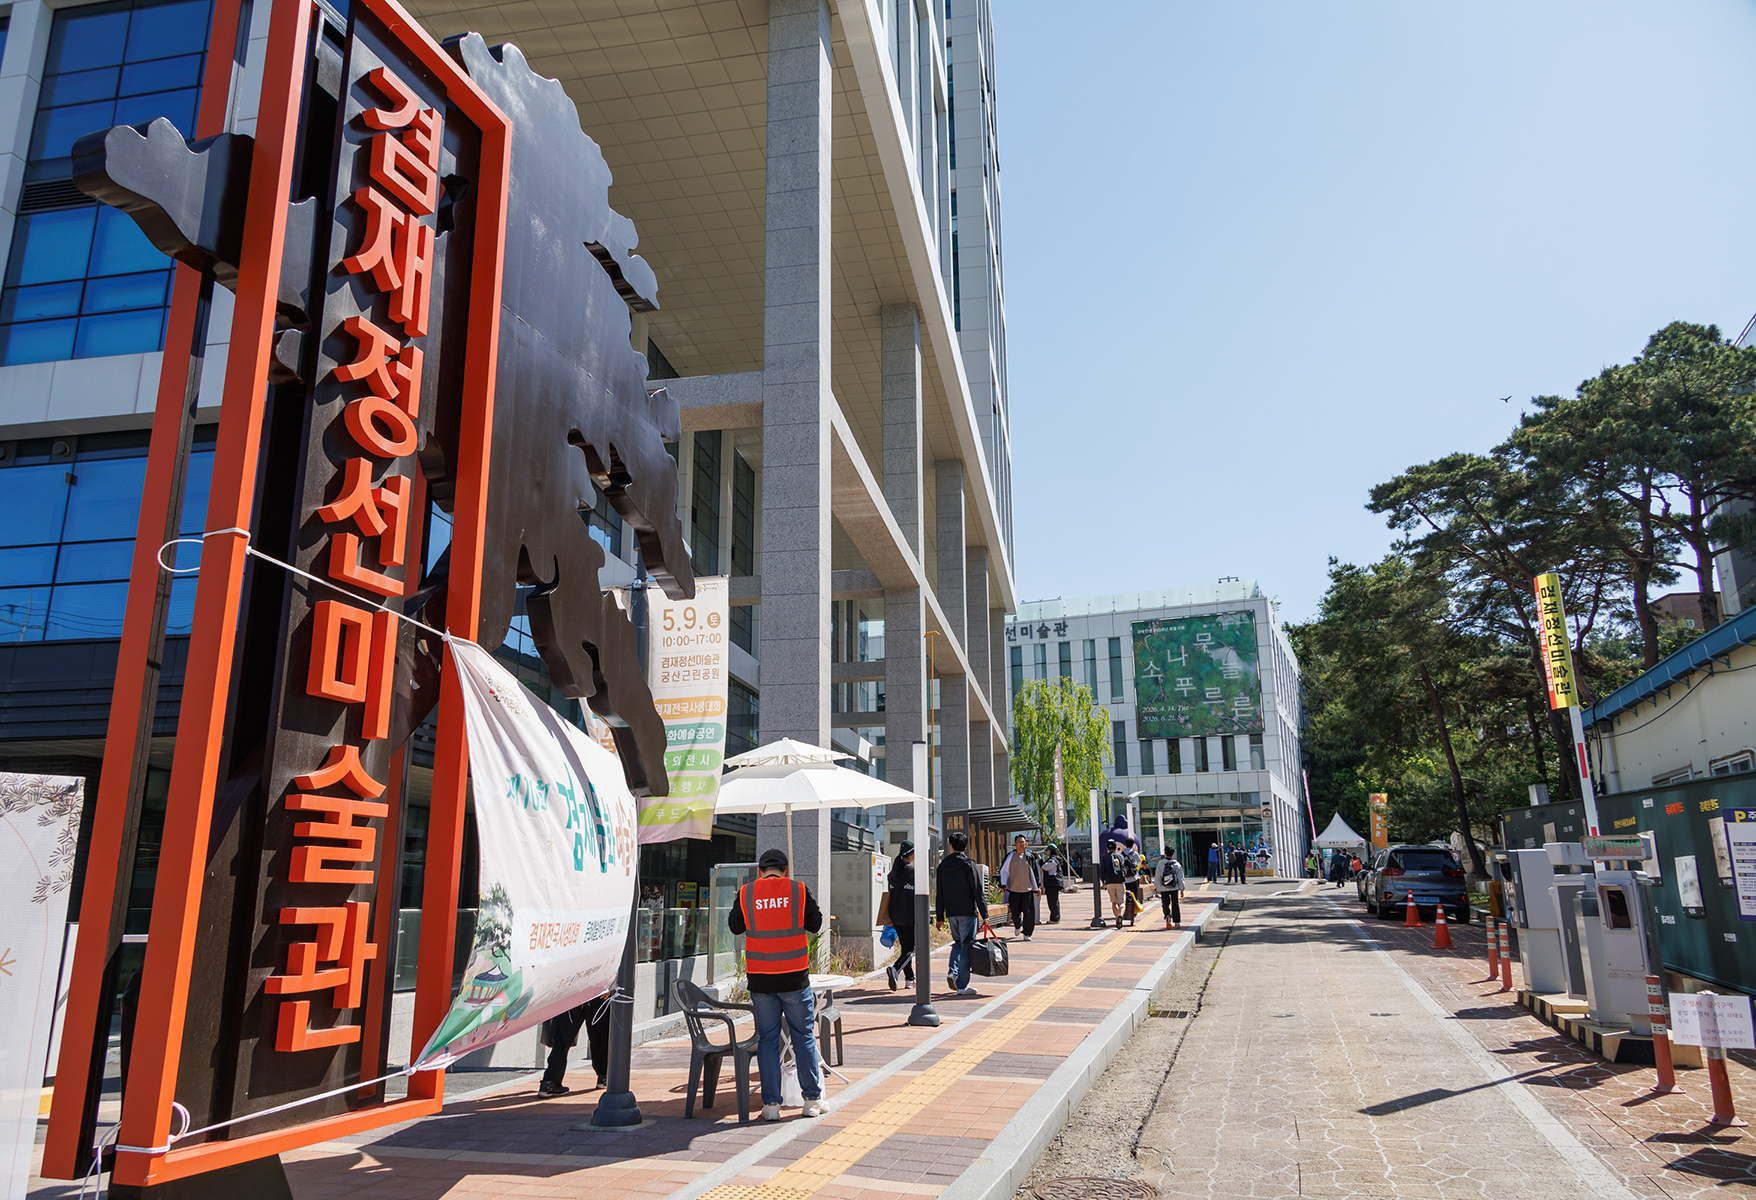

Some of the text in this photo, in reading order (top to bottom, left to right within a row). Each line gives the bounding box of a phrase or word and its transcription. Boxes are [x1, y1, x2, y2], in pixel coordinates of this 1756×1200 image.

[264, 66, 443, 1052] 겸재정선미술관
[662, 606, 720, 632] 5.9. 토
[662, 633, 722, 647] 10:00-17:00
[1005, 621, 1068, 642] 선미술관
[1541, 585, 1571, 695] 겸재정선미술관
[662, 654, 720, 668] 겸재정선미술관
[661, 668, 720, 683] 궁산근린공원
[655, 700, 721, 716] 겸재전국사생대회
[666, 728, 714, 741] 화예술공연
[506, 773, 550, 811] 제10회
[756, 897, 789, 910] STAFF
[530, 922, 582, 950] 겸재전국사생대회
